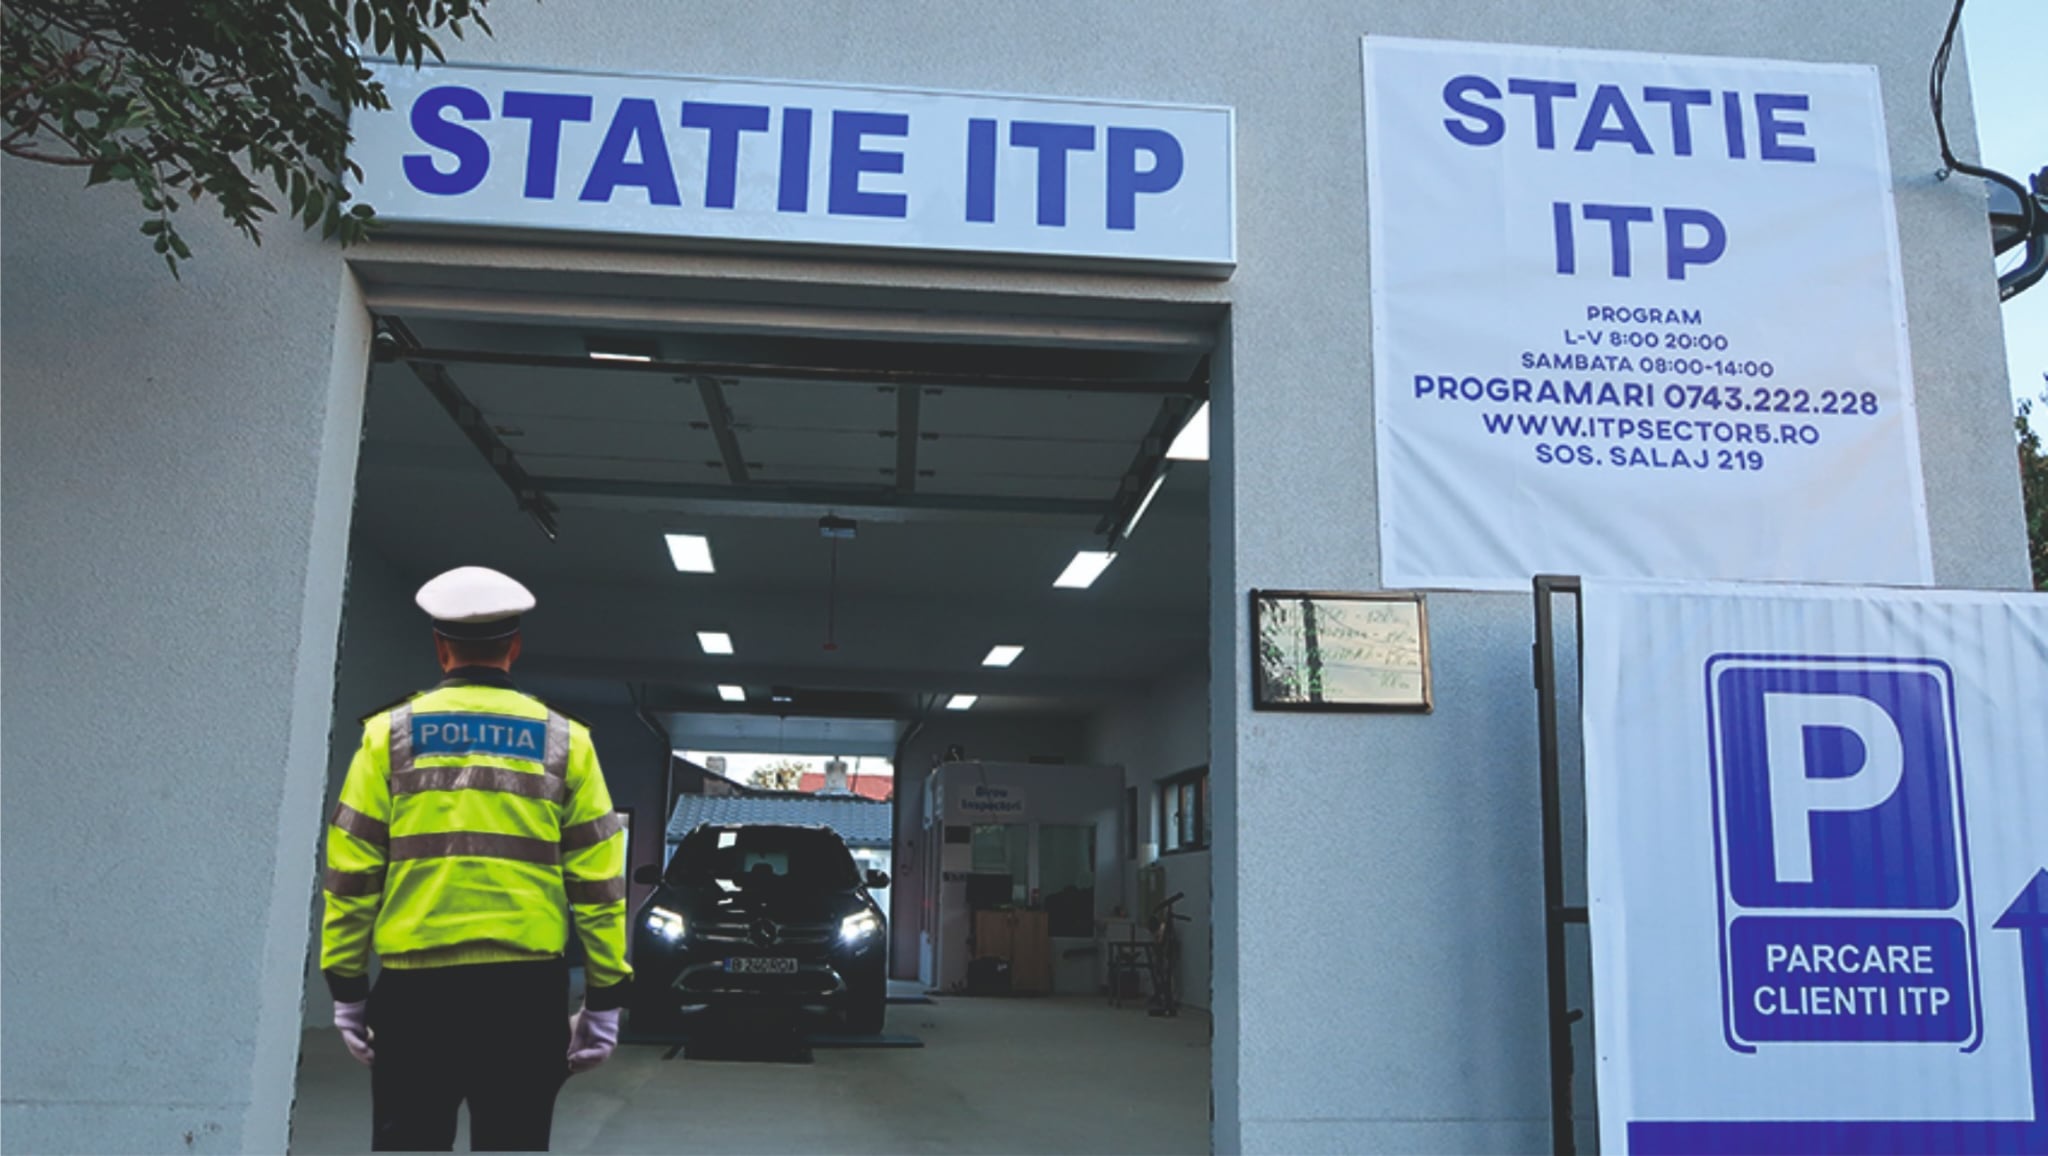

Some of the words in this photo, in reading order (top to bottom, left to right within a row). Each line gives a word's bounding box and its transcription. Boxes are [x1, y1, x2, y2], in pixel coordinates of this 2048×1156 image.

[1442, 75, 1816, 163] STATIE
[402, 85, 909, 219] STATIE
[965, 117, 1184, 231] ITP
[1552, 201, 1727, 280] ITP
[1587, 305, 1702, 325] PROGRAM
[1564, 329, 1603, 346] L-V
[1609, 331, 1660, 348] 8:00
[1664, 332, 1729, 351] 20:00
[1521, 351, 1634, 372] SAMBATA
[1639, 356, 1774, 378] 08:00-14:00
[1414, 374, 1654, 408] PROGRAMARI
[1663, 383, 1879, 416] 0743.222.228
[1482, 413, 1820, 445] WWW.ITPSECTOR5.RO
[1535, 442, 1603, 466] SOS.
[1609, 445, 1710, 469] SALAJ
[1717, 449, 1764, 471] 219
[420, 722, 535, 750] POLITIA
[1763, 692, 1904, 883] P
[1766, 944, 1934, 974] PARCARE
[1754, 985, 1888, 1015] CLIENTI
[1899, 986, 1950, 1015] ITP
